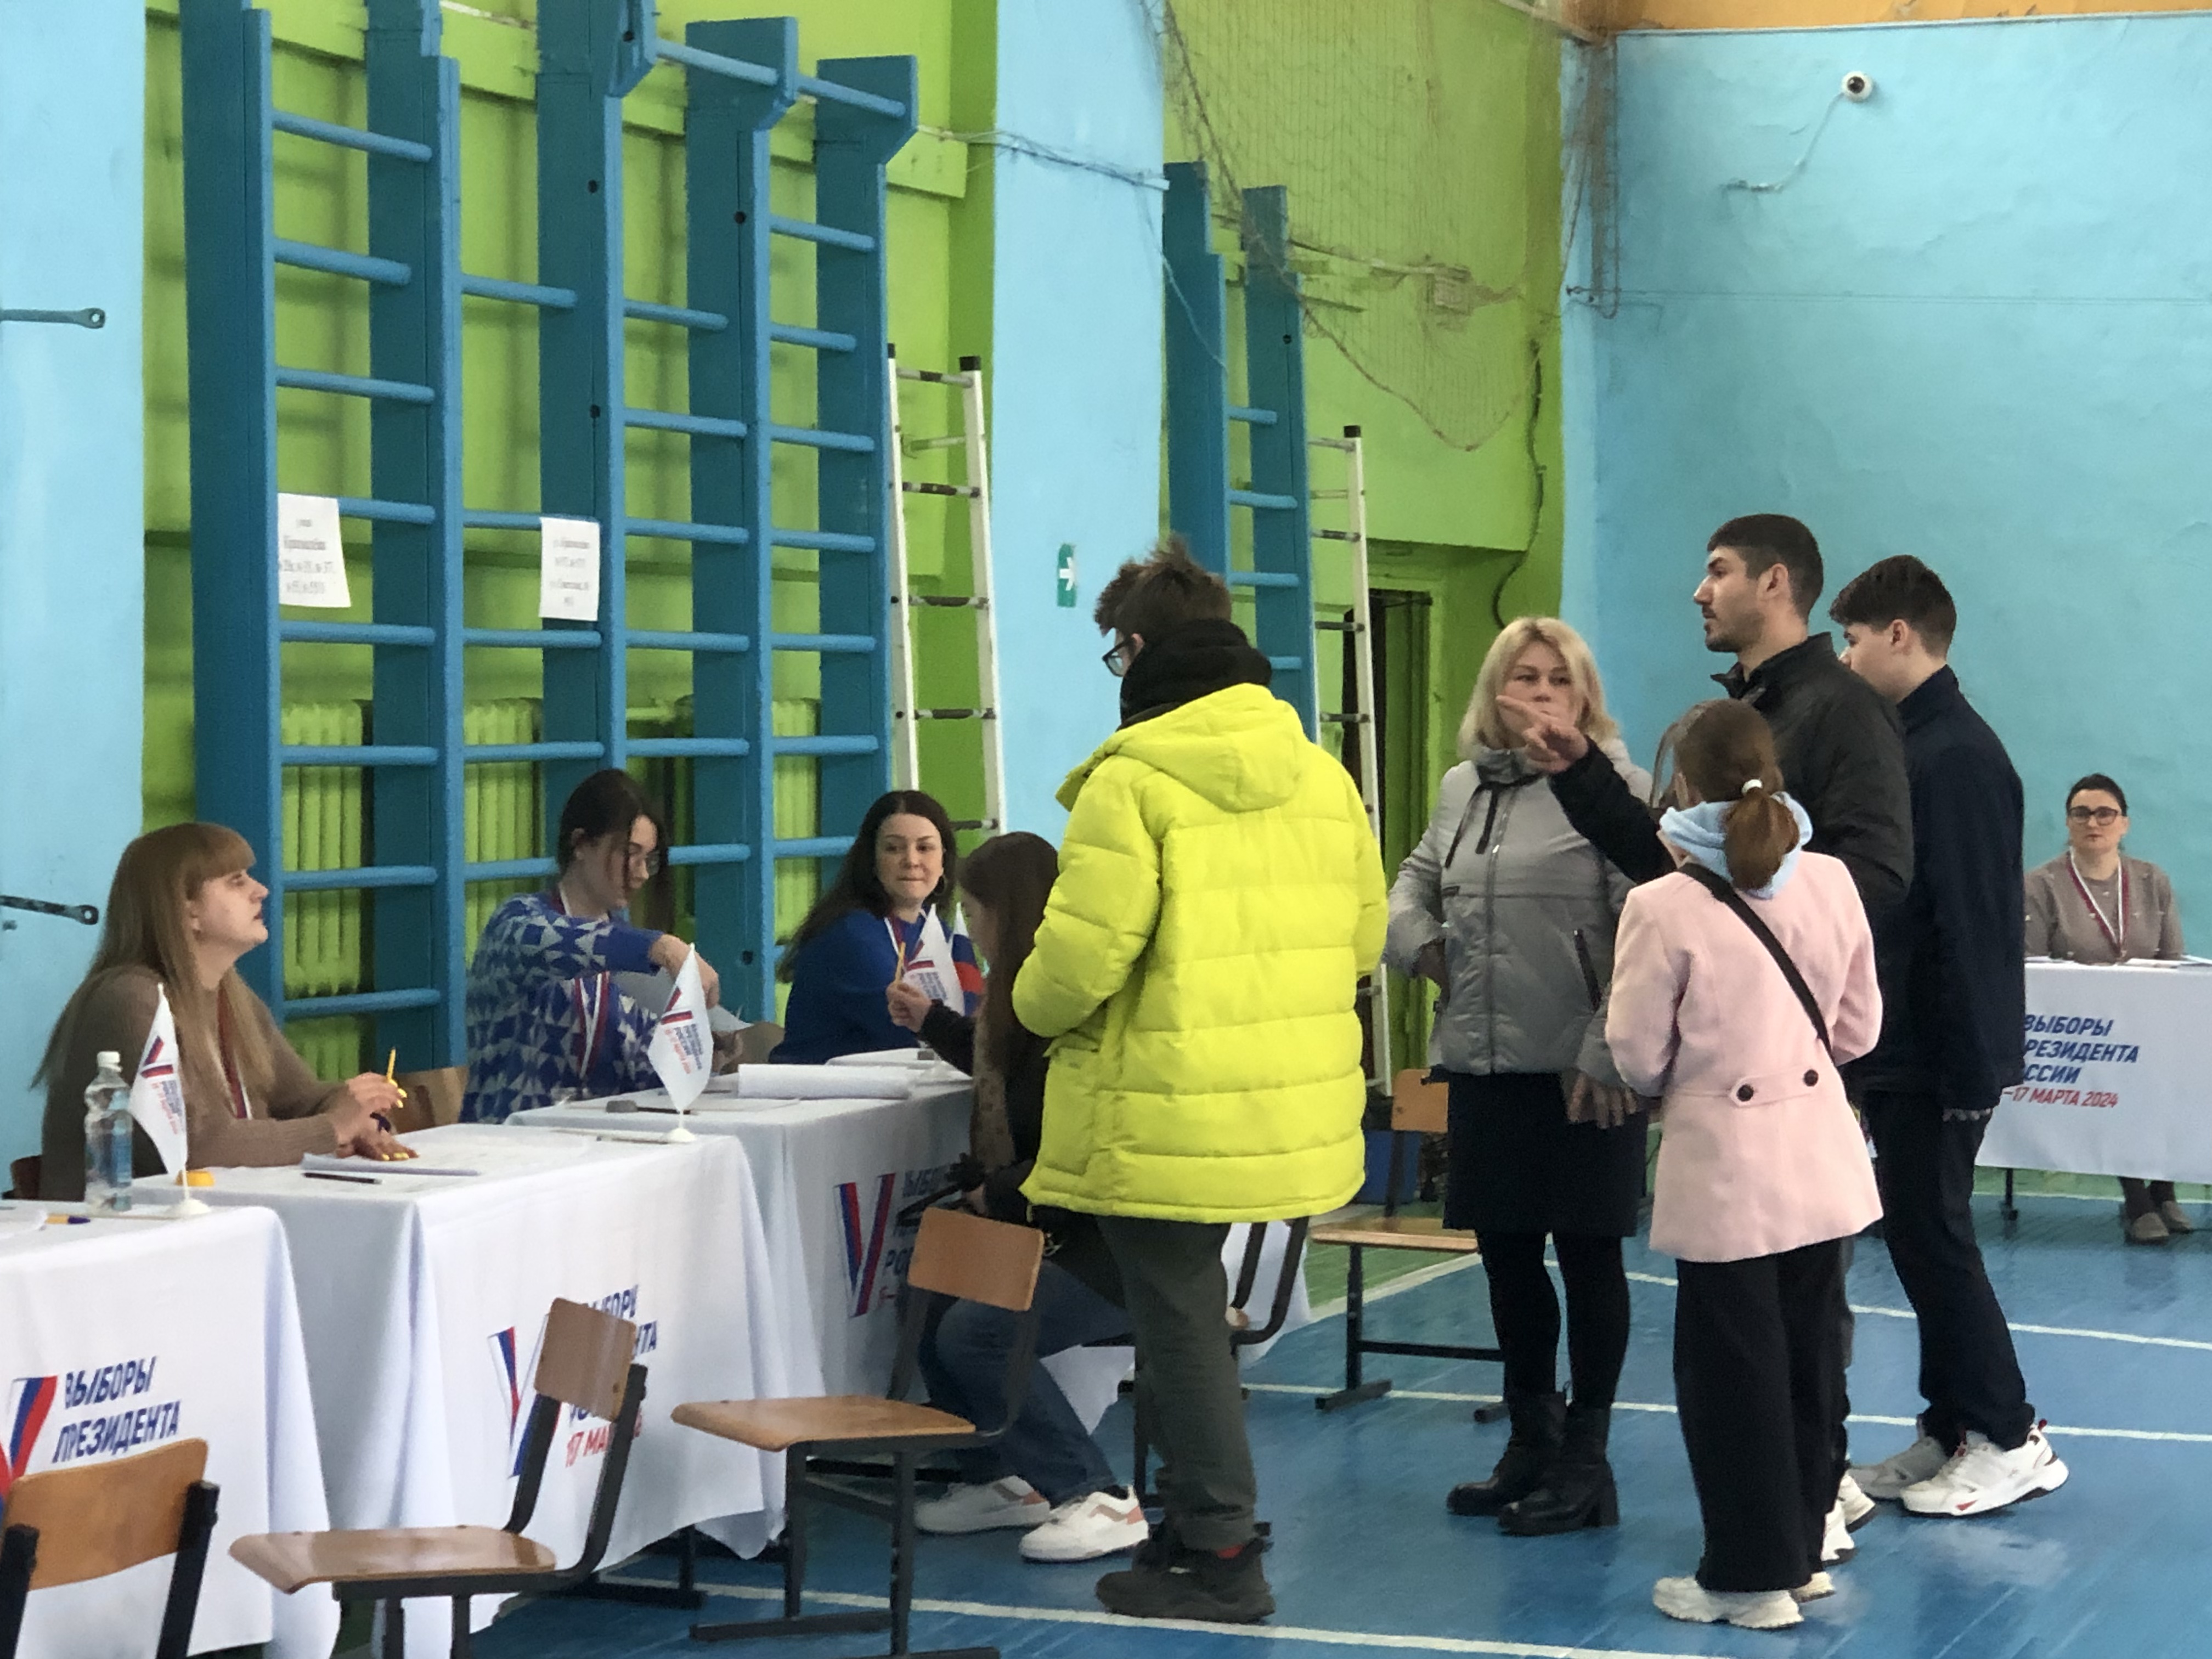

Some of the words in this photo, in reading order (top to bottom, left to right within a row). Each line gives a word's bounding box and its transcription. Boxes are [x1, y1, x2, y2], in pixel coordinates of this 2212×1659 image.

[2024, 1014, 2114, 1036] ВЫБОРЫ
[2025, 1039, 2140, 1063] РЕЗИДЕНТА
[2024, 1063, 2081, 1084] ССИИ
[2029, 1088, 2080, 1107] МАРТА
[2083, 1091, 2119, 1108] 2024
[65, 1356, 157, 1409] ВЫБОРЫ
